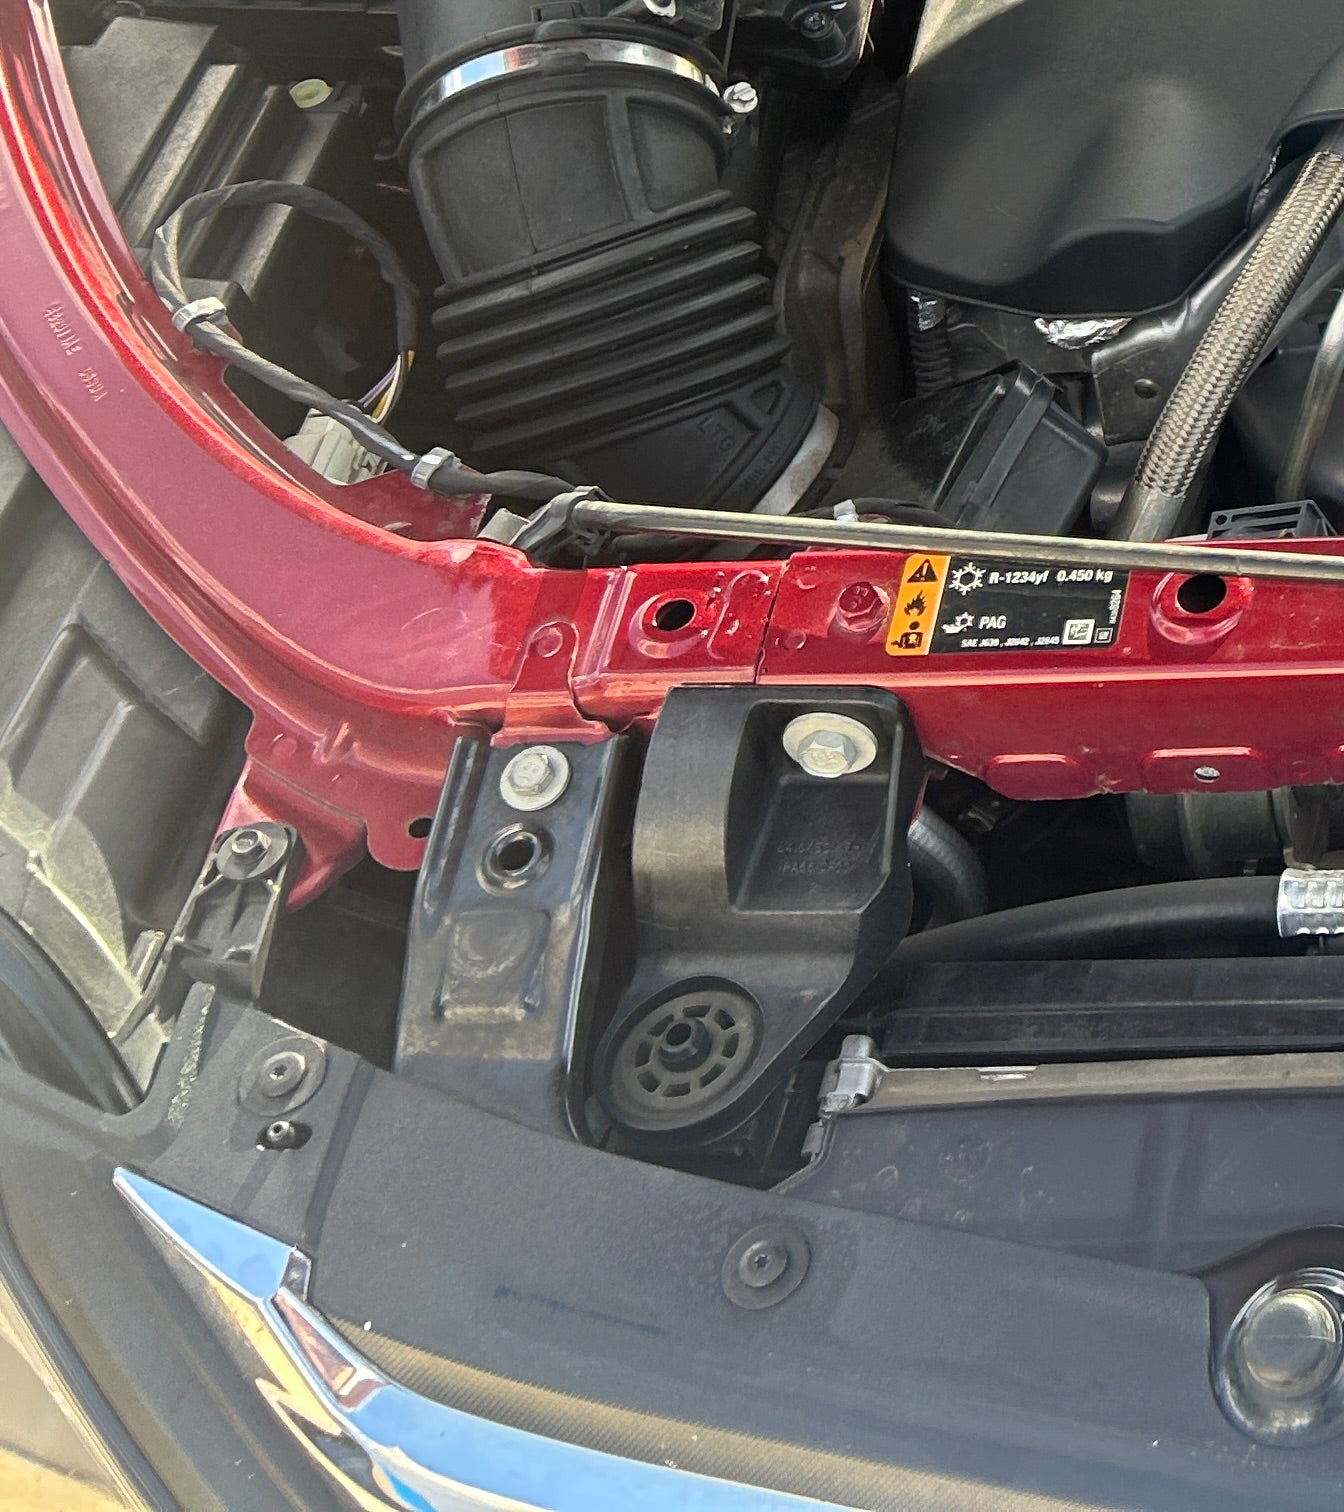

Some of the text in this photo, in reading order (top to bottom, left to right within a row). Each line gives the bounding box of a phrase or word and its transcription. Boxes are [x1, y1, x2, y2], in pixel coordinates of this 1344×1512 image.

[988, 569, 1113, 586] R-1234yf 0.450 kg
[978, 616, 1007, 630] PAG
